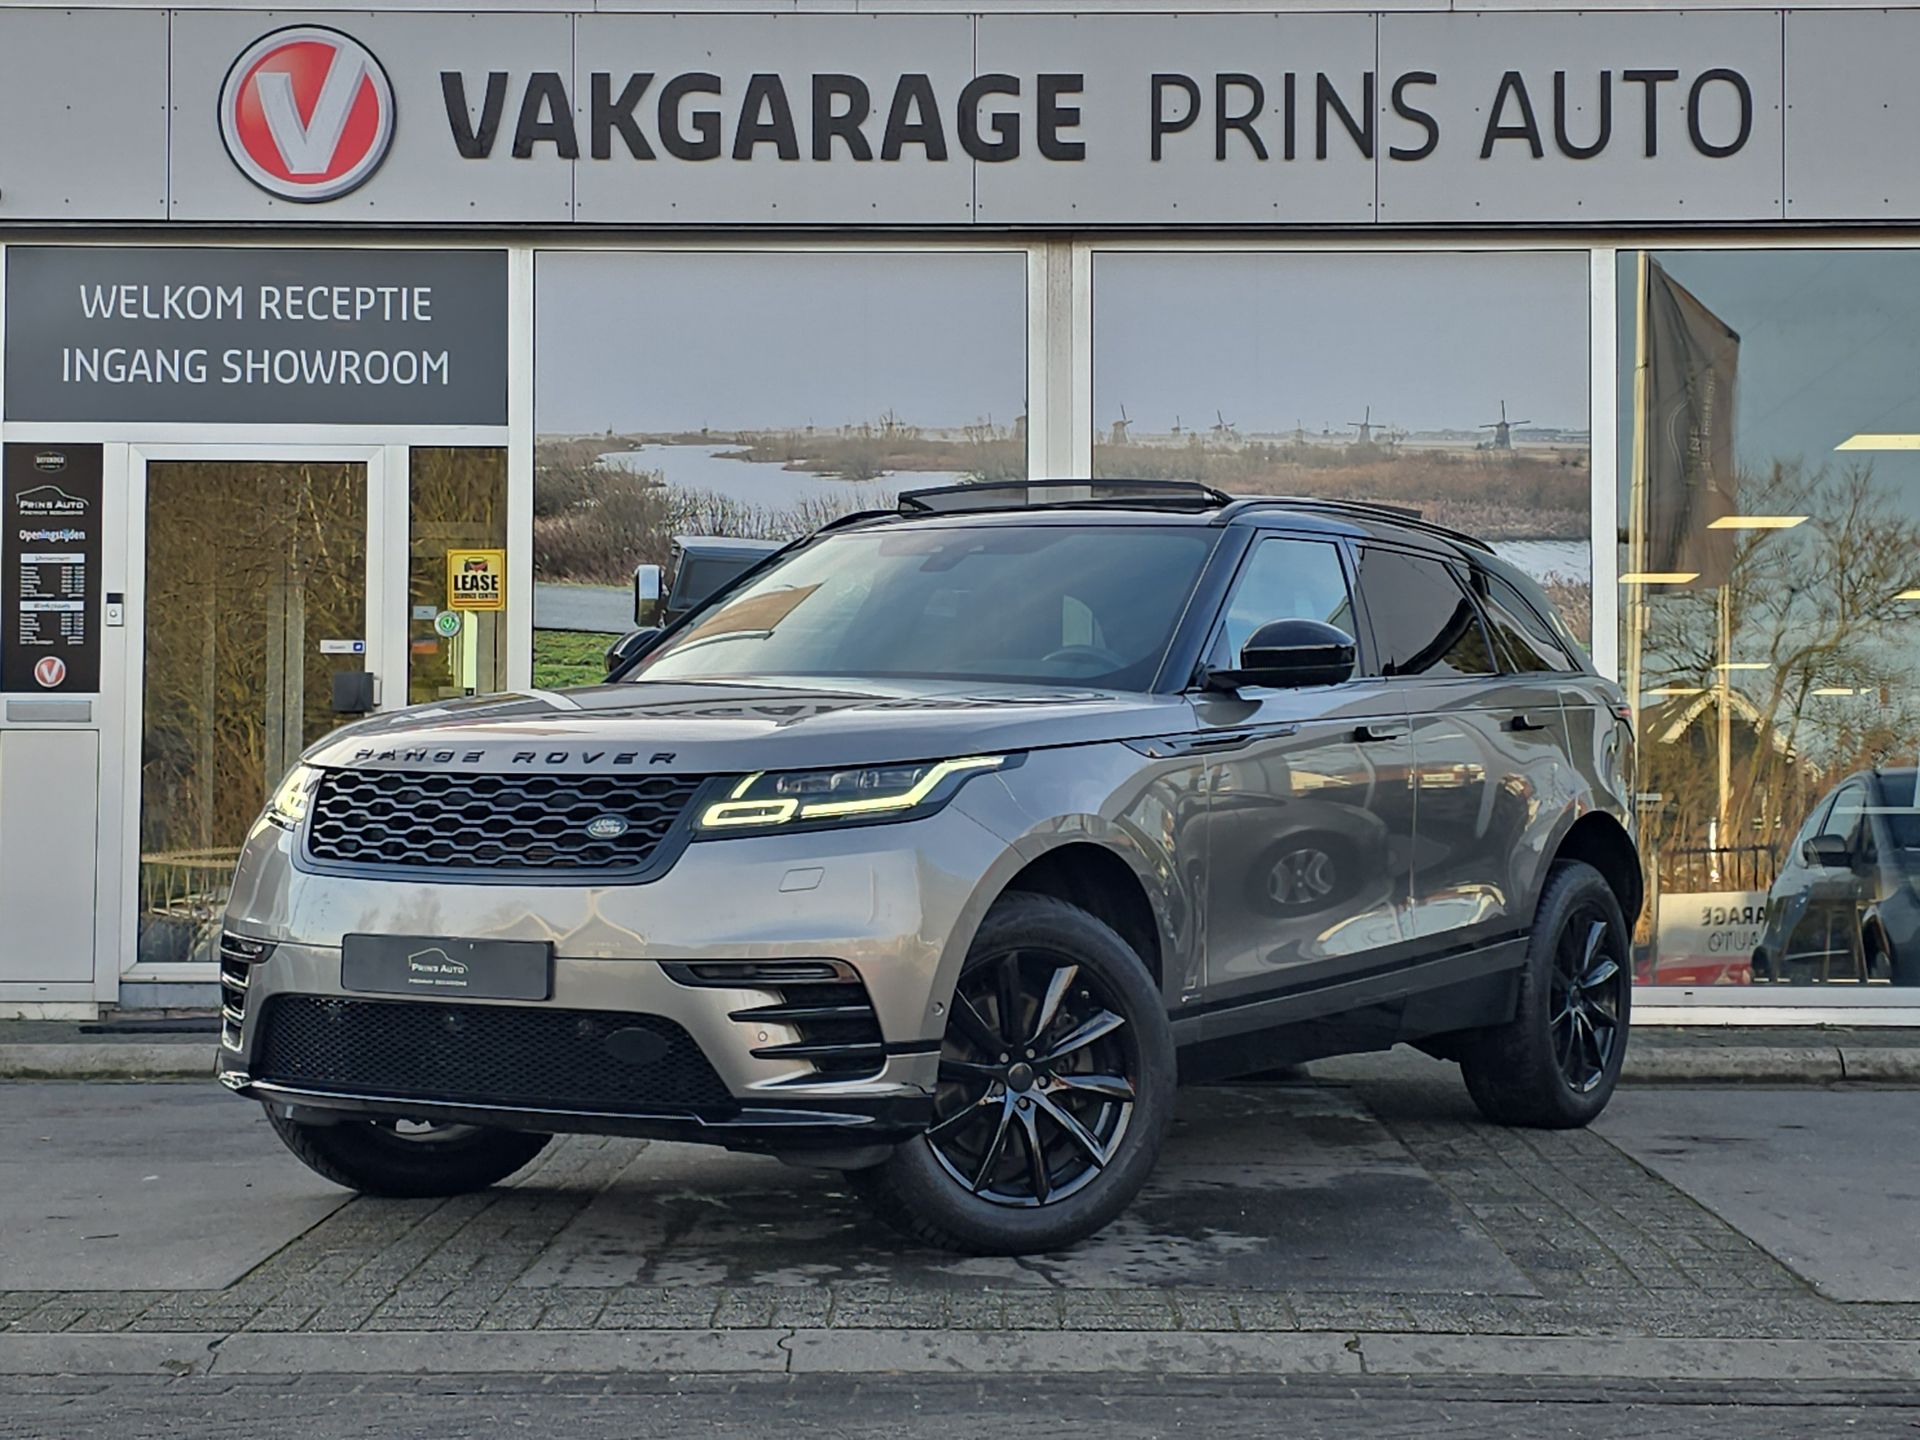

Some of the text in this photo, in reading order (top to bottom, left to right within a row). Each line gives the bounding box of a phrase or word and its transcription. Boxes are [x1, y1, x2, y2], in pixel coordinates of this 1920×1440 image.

[440, 68, 1753, 161] VAKGARAGE PRINS AUTO
[80, 284, 432, 321] WELKOM RECEPTIE
[62, 347, 449, 386] INGANG SHOWROOM
[19, 528, 86, 542] Openingstijden
[453, 574, 499, 592] LEASE
[354, 748, 677, 765] RANGE ROVER
